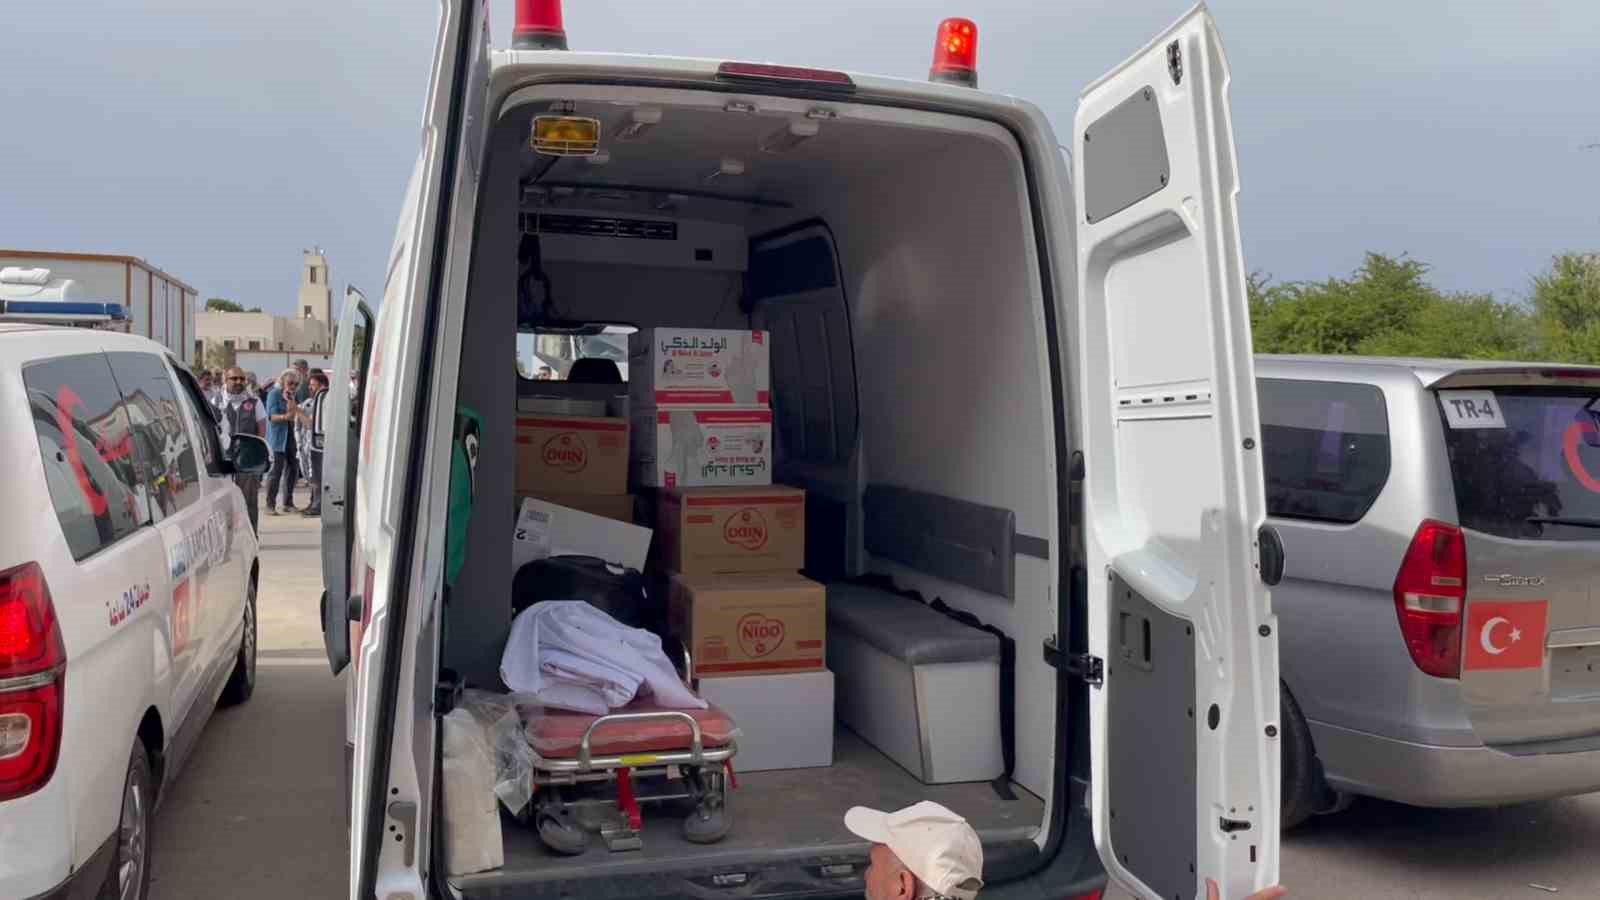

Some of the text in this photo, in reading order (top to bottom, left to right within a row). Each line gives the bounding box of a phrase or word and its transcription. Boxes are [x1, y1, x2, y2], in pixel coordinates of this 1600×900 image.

[1450, 399, 1495, 418] TR-4
[727, 527, 763, 538] NIDO
[742, 624, 780, 640] NIDO
